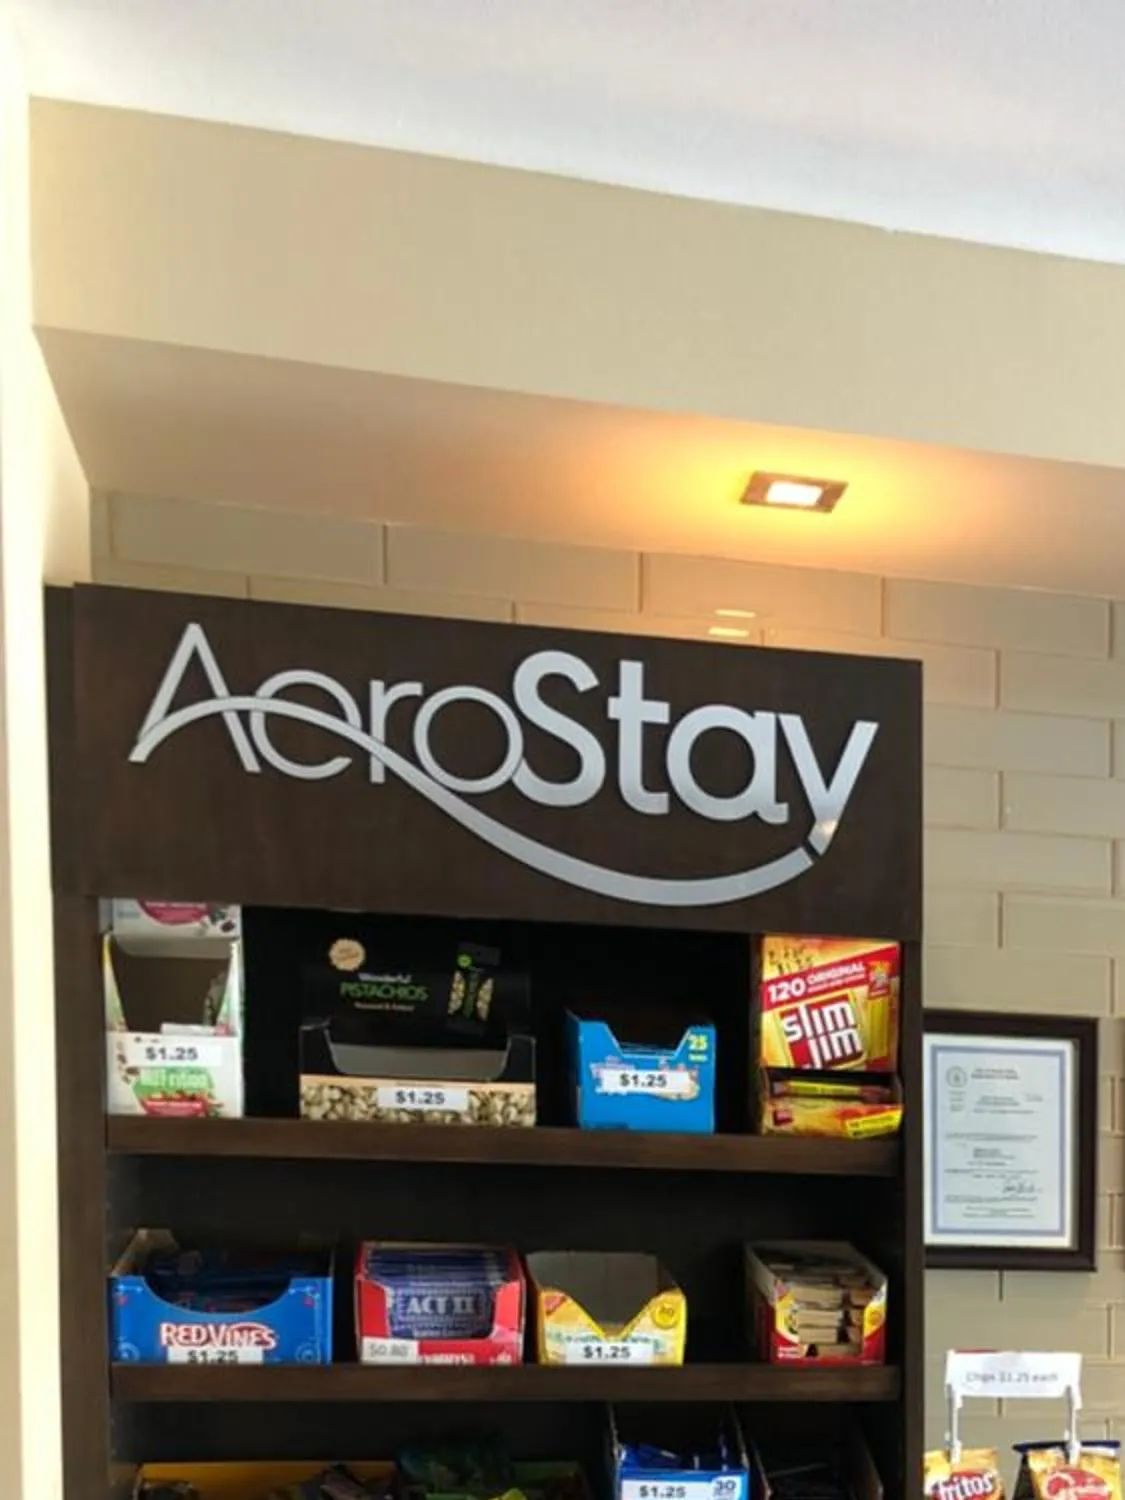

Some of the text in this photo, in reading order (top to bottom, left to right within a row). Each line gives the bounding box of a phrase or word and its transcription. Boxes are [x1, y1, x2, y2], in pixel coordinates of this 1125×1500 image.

[127, 622, 879, 880] AeroStay
[340, 981, 429, 1002] PISTACHIOS
[767, 978, 806, 1003] 120
[145, 1046, 199, 1062] $1.25
[619, 1073, 668, 1088] $1.25
[395, 1090, 446, 1105] $1.25
[406, 1296, 449, 1314] ACT
[187, 1350, 240, 1364] $1.25
[583, 1345, 631, 1359] $1.25
[965, 1371, 1060, 1383] Chips $1.25 each
[639, 1485, 687, 1499] $1.25
